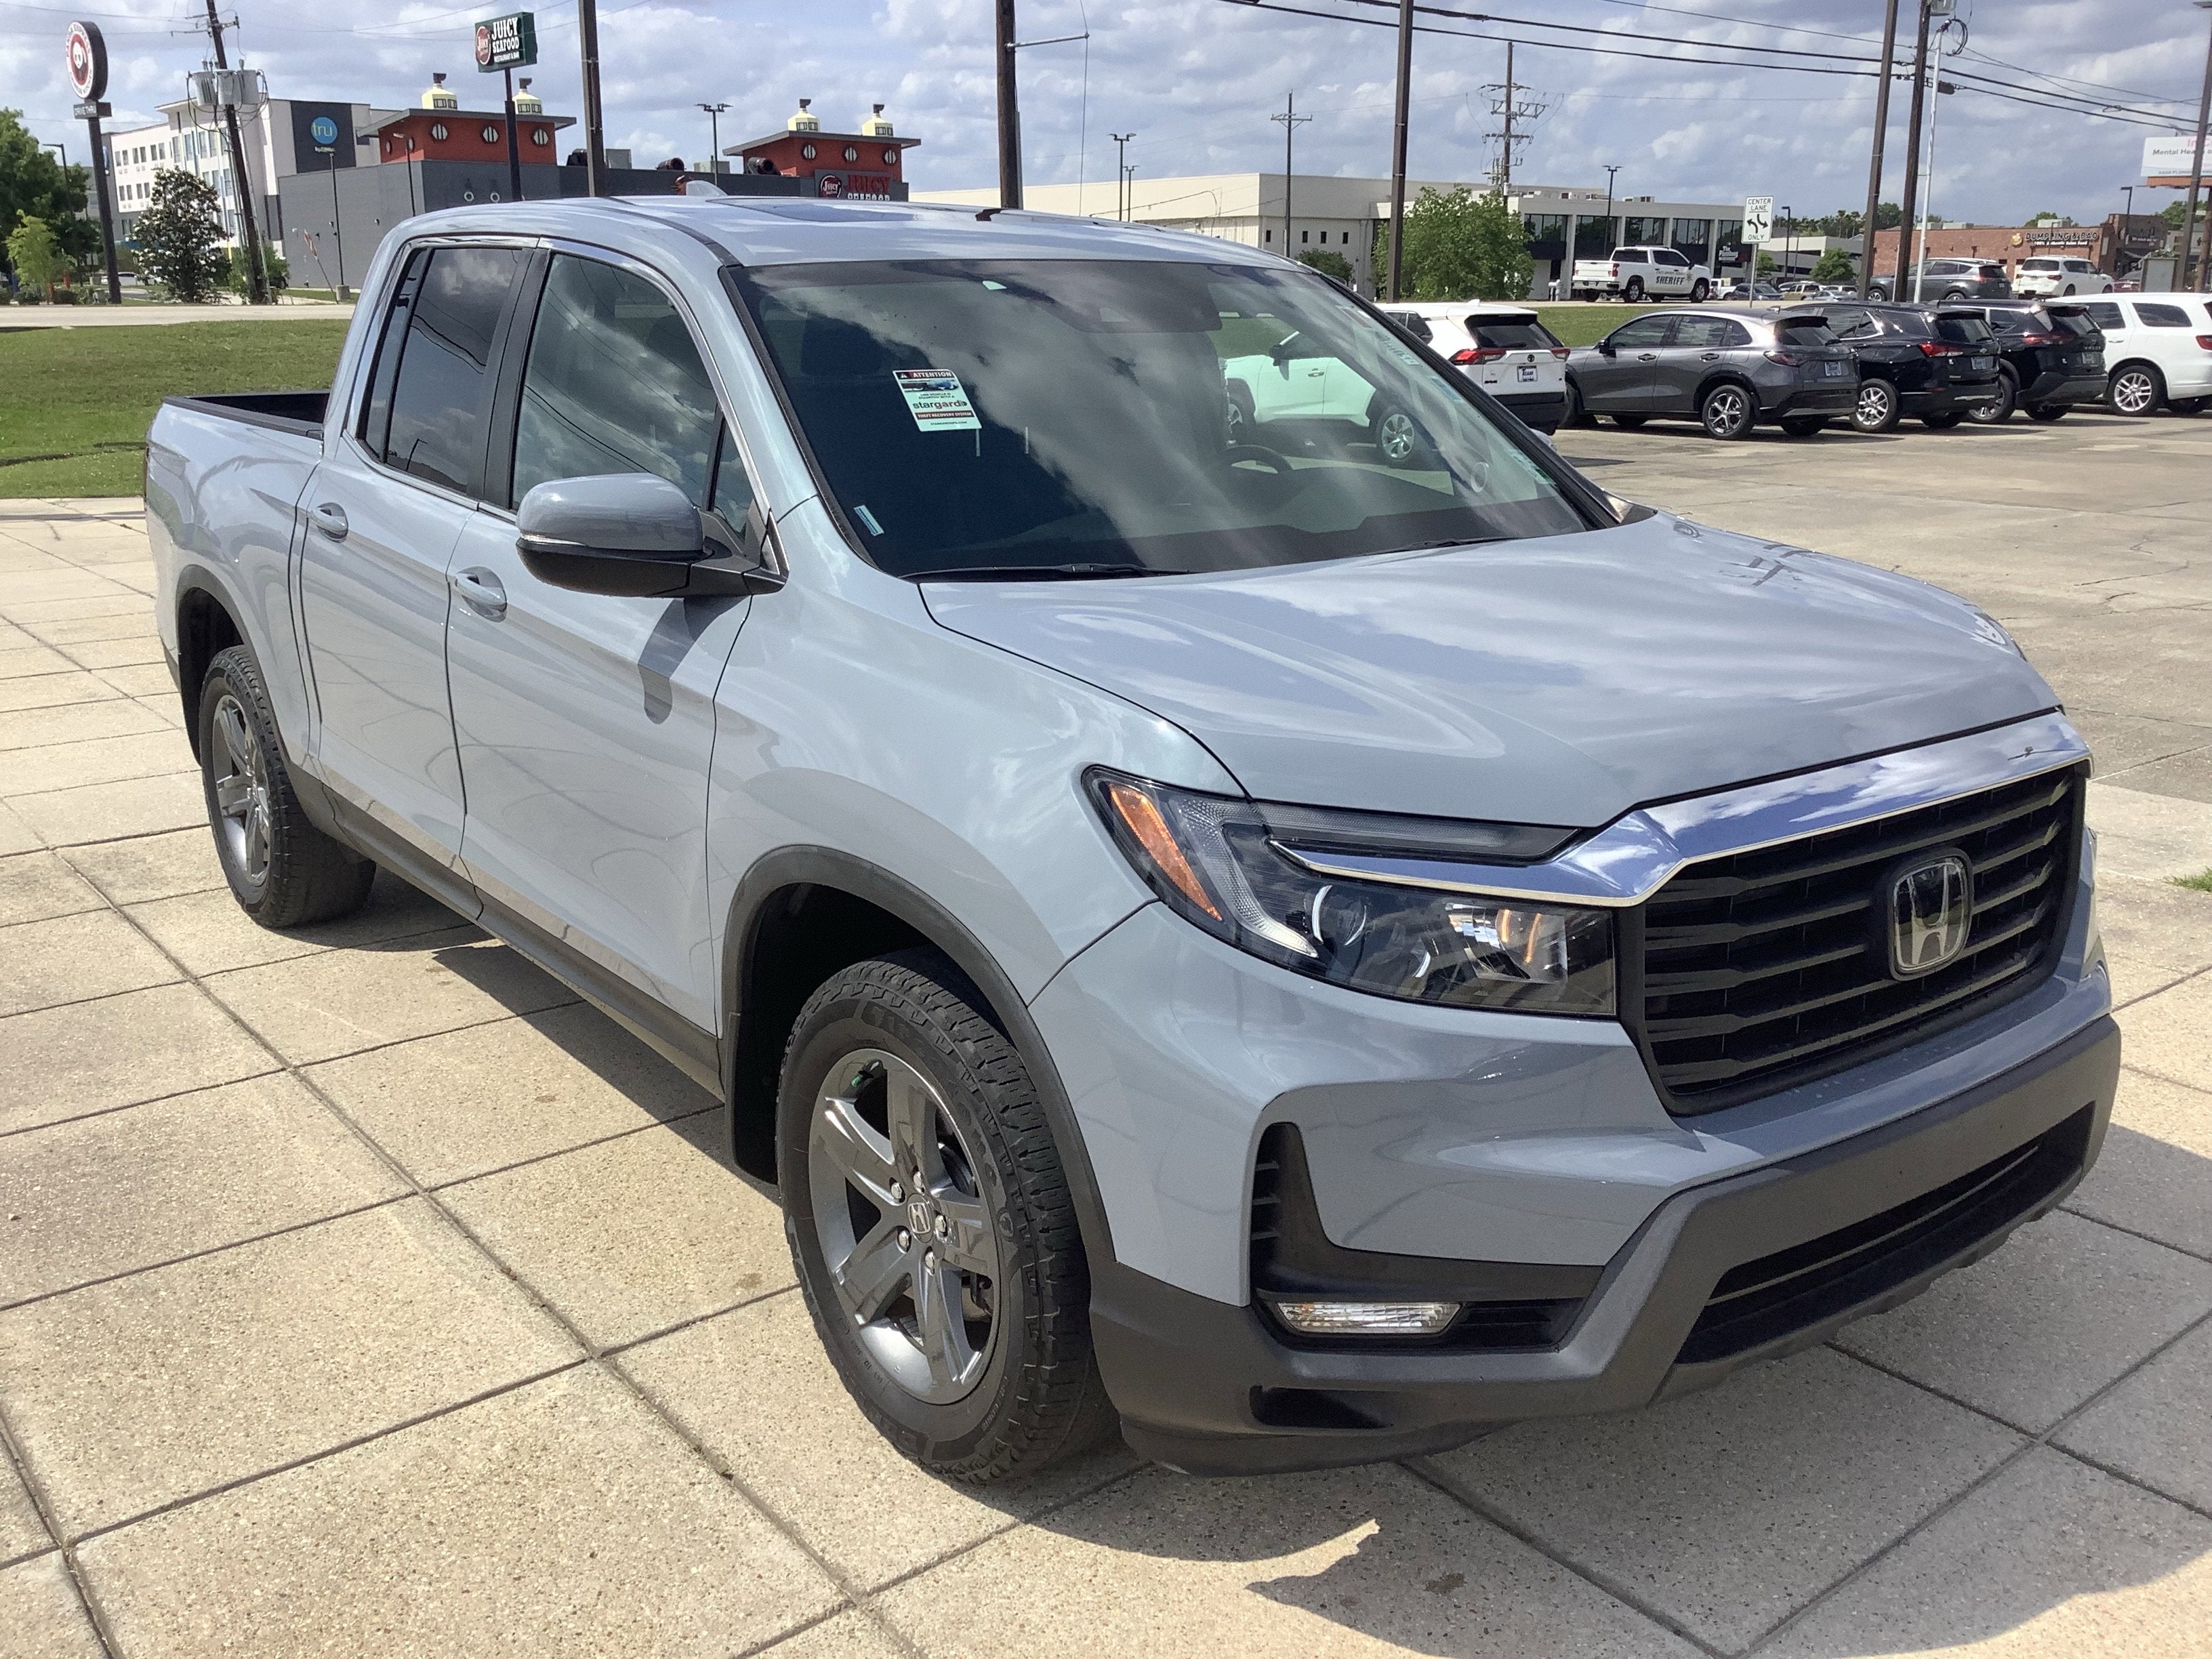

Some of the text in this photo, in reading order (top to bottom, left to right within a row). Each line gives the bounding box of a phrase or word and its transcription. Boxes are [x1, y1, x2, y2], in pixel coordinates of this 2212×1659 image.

[491, 17, 518, 41] JUICY
[492, 36, 520, 54] SEAFOOD
[312, 122, 333, 137] tru
[844, 175, 890, 194] JUICY
[1656, 276, 1685, 285] SHERIFF
[912, 400, 962, 409] stargard
